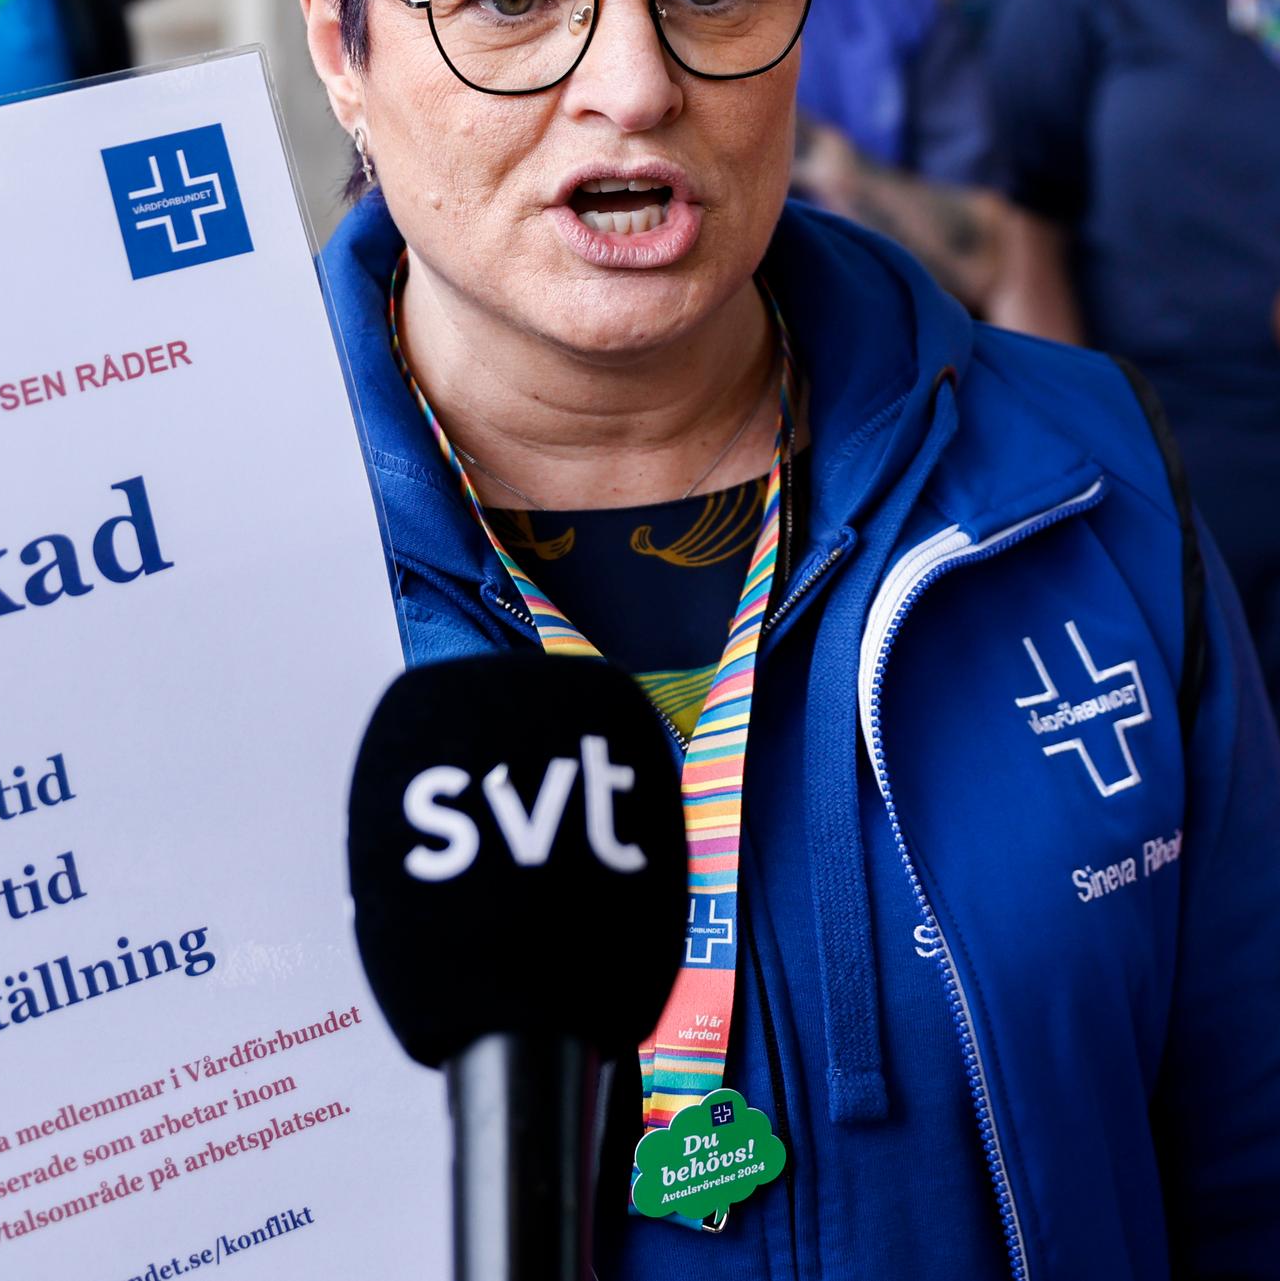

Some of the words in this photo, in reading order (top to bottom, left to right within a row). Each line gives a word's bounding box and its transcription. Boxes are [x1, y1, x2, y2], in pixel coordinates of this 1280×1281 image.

[132, 189, 212, 215] VÅRDFÖRBUNDET
[73, 339, 194, 401] RÅDER
[403, 734, 648, 882] svt
[1072, 854, 1138, 904] Sineva
[687, 925, 726, 935] ÖRBUNDET
[677, 1029, 721, 1042] vården
[695, 1014, 708, 1027] Vi
[710, 1015, 724, 1028] är
[15, 1078, 166, 1147] medlemmar
[169, 1068, 183, 1090] i
[182, 1005, 363, 1083] Vårdförbundet
[83, 1135, 136, 1166] som
[140, 1098, 229, 1147] arbetar
[232, 1074, 298, 1111] inom
[147, 1157, 181, 1193] på
[183, 1099, 352, 1173] arbetsplatsen.
[661, 1139, 755, 1187] behövs!
[683, 1133, 719, 1157] Du
[661, 1172, 736, 1205] Avtalsrörelse
[737, 1161, 766, 1180] 2024
